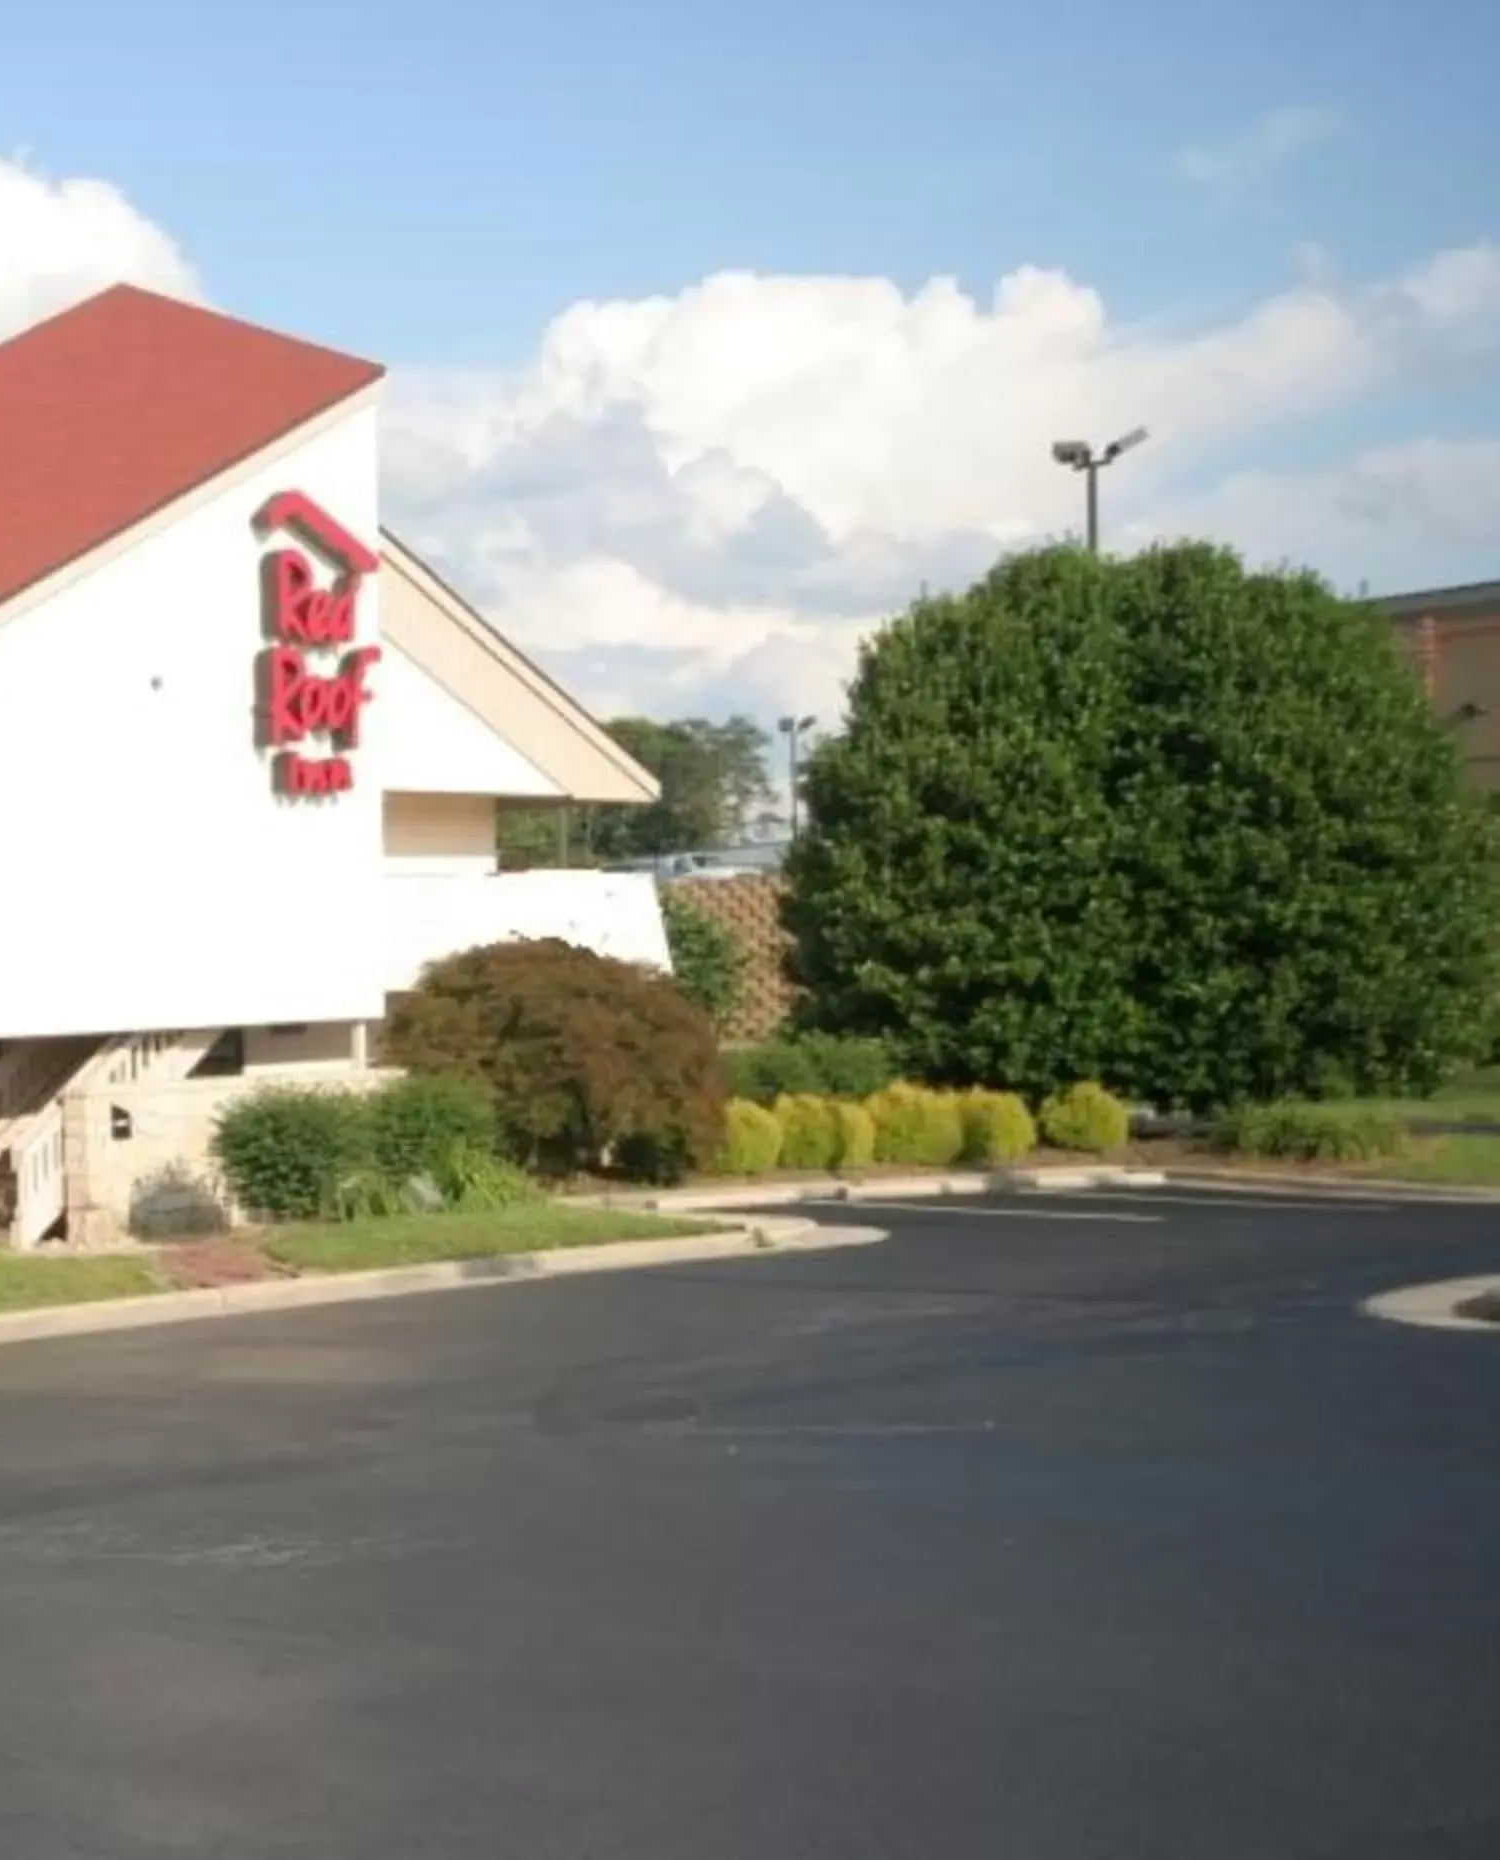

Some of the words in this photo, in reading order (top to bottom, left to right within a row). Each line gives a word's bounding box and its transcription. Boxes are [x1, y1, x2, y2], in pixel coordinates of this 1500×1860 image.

[276, 548, 360, 645] Red
[270, 646, 382, 749] Roof
[287, 754, 354, 796] Inn
